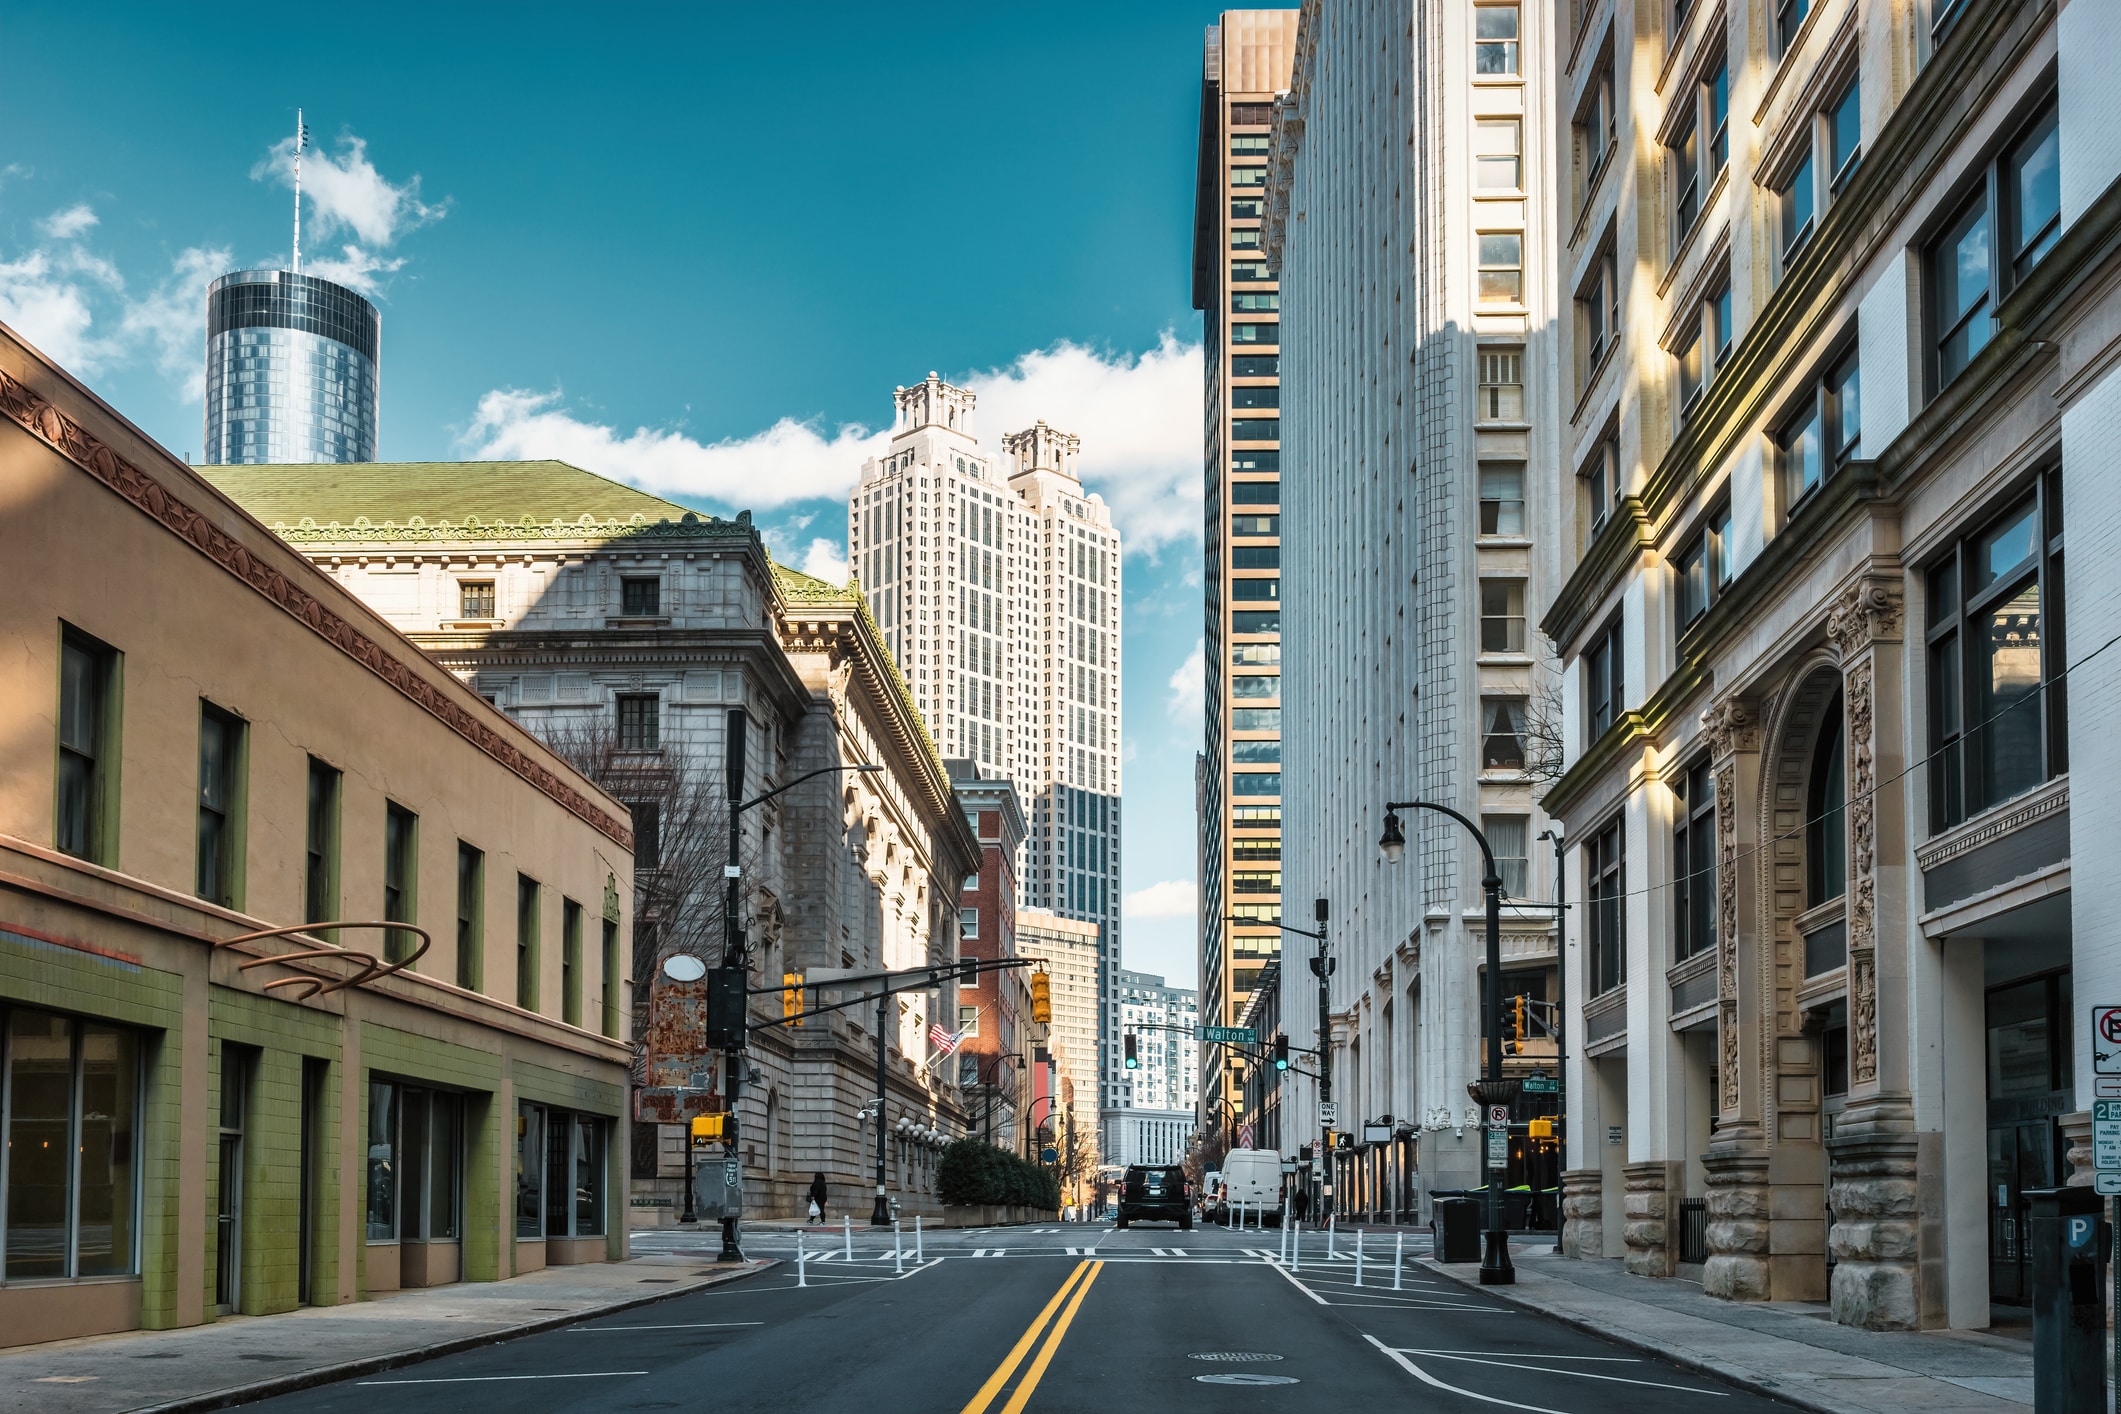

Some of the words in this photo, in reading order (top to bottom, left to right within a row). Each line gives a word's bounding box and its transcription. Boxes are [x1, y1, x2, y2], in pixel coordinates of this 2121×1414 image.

[1206, 1028, 1244, 1040] Walton
[1524, 1081, 1545, 1089] Walton
[2096, 1104, 2107, 1119] 2
[2072, 1219, 2087, 1241] P
